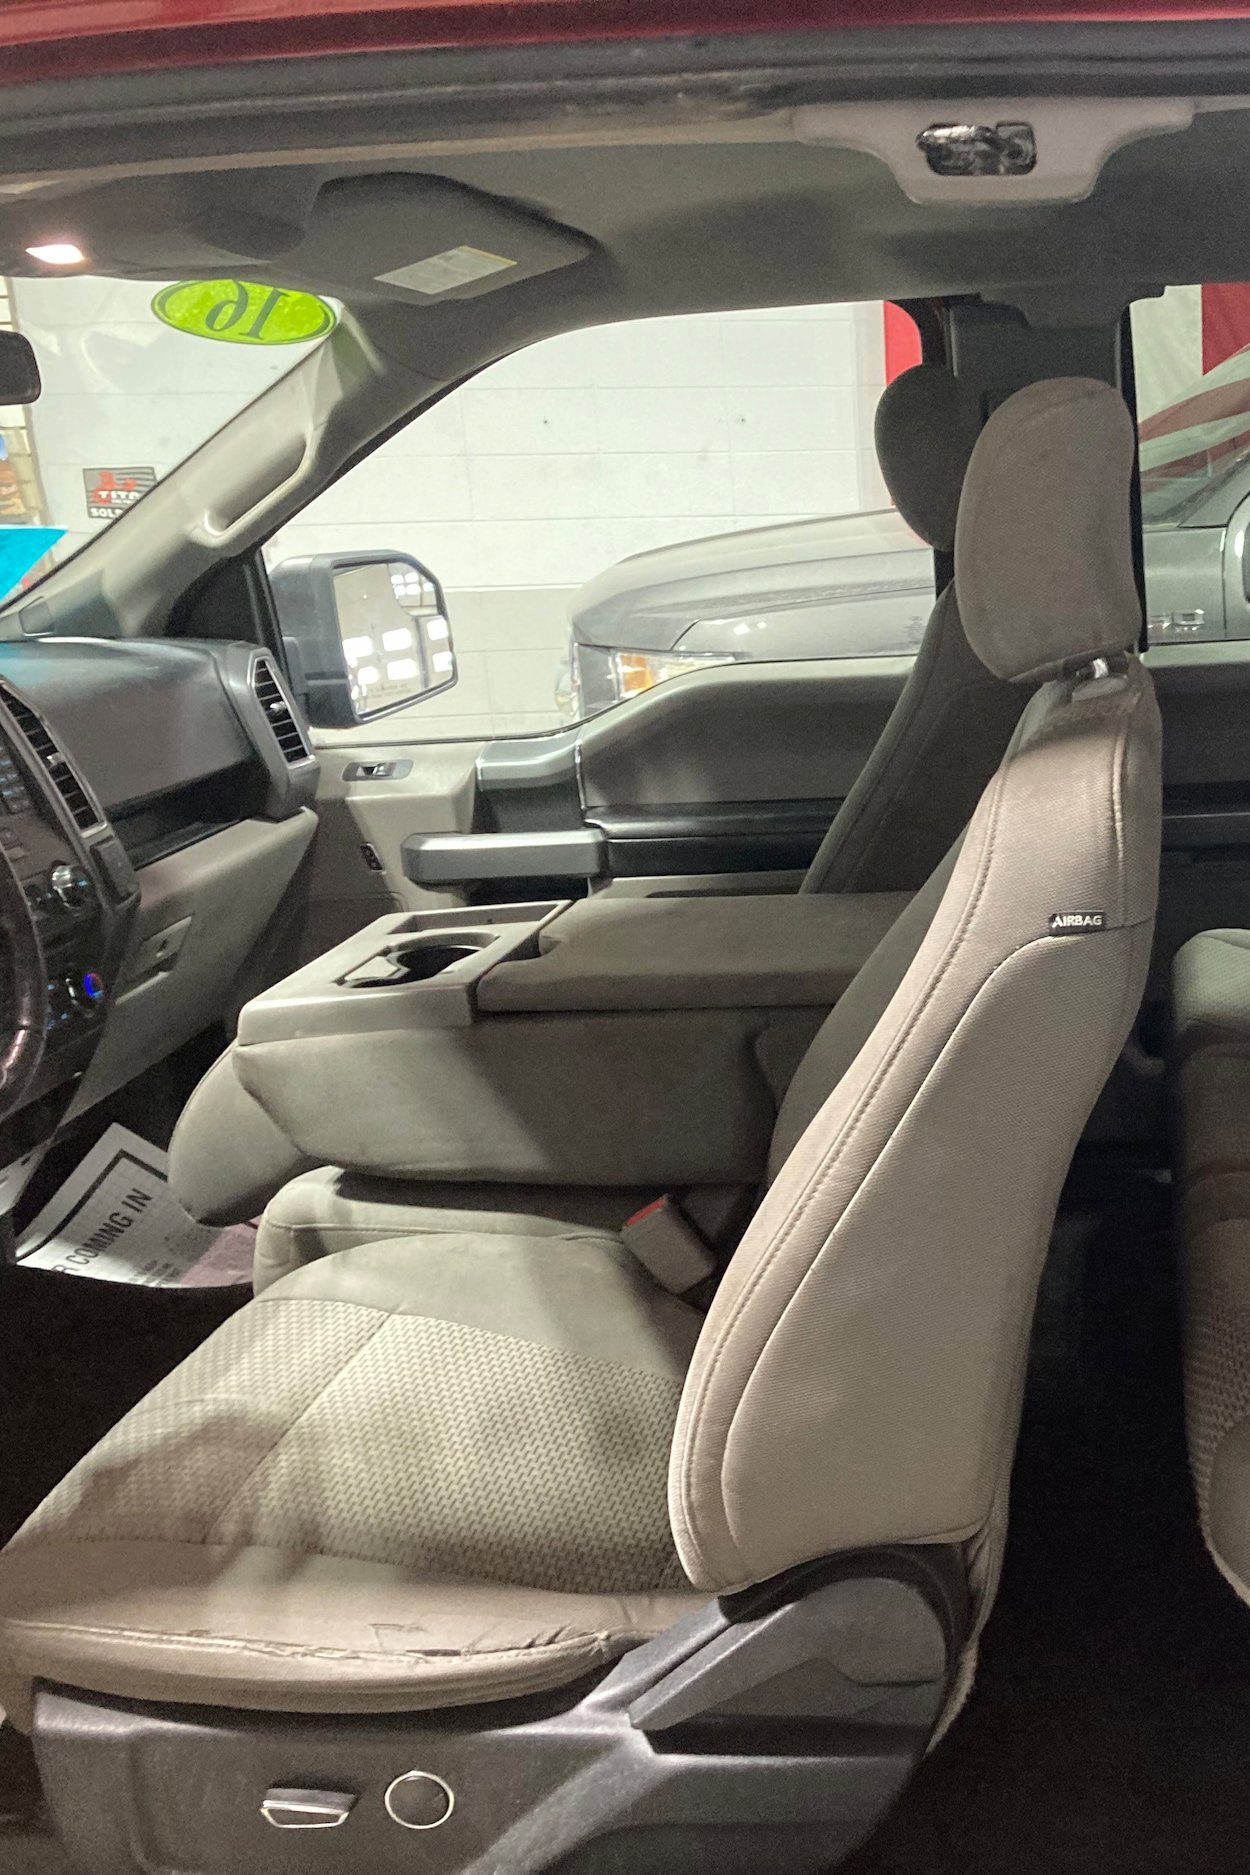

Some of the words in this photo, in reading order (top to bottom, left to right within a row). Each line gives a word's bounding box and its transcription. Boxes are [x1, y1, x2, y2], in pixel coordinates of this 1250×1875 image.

[1051, 914, 1103, 928] AIRBAG
[65, 1212, 134, 1265] COMING
[121, 1187, 152, 1213] IN
